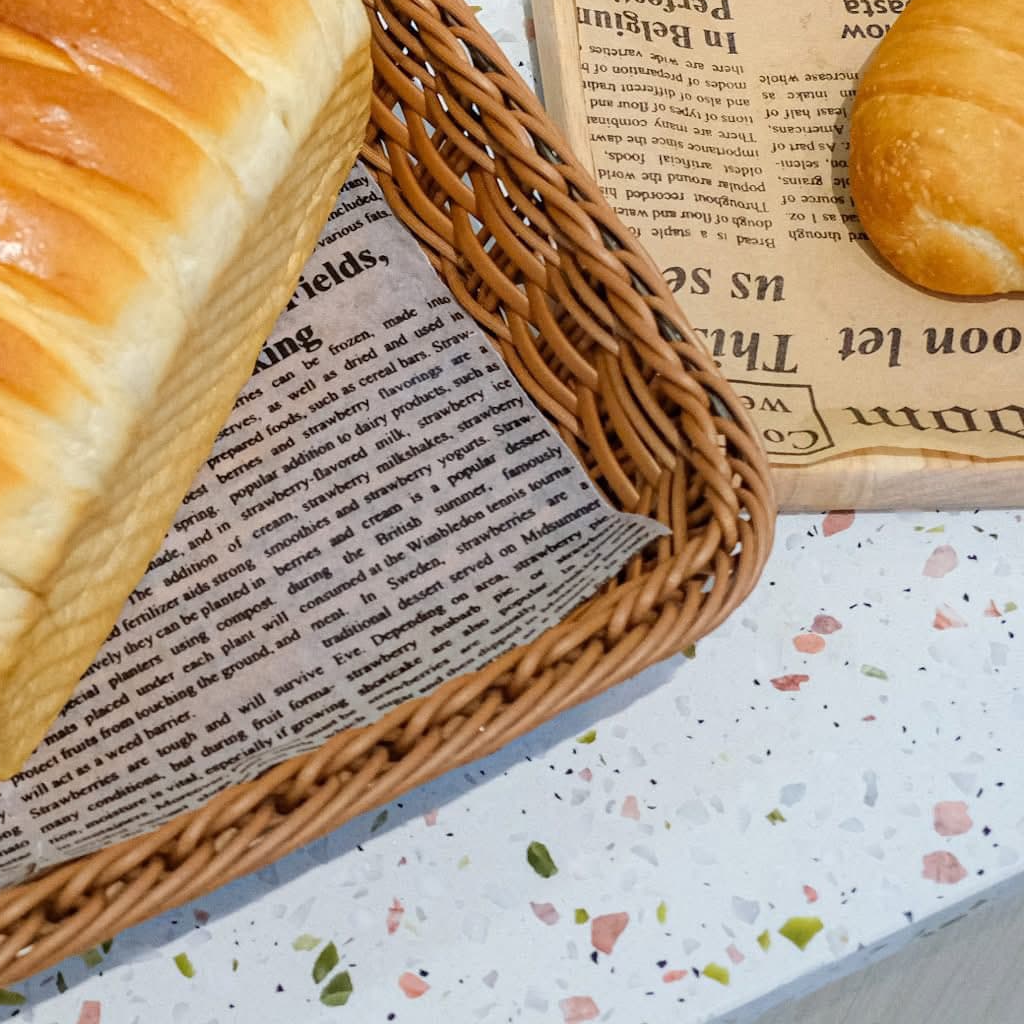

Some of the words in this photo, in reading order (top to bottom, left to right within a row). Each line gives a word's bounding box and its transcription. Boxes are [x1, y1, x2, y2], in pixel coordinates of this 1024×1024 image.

[843, 0, 911, 20] asta
[704, 29, 738, 54] In
[769, 122, 846, 139] Americans,
[659, 155, 712, 169] artificial
[598, 169, 635, 179] world
[668, 173, 712, 185] around
[626, 190, 684, 202] recorded
[718, 180, 766, 192] popular
[694, 194, 768, 212] Throughout
[652, 226, 690, 239] staple
[736, 235, 775, 248] Bread
[789, 229, 841, 242] through
[731, 272, 785, 302] us
[328, 331, 375, 355] frozen,
[383, 309, 417, 329] made
[427, 297, 451, 309] into
[838, 327, 901, 367] let
[266, 413, 307, 436] foods,
[359, 362, 397, 386] cereal
[375, 429, 410, 450] milk,
[375, 516, 422, 546] British
[435, 484, 493, 516] summer,
[502, 447, 562, 480] famously
[406, 511, 485, 552] Wimbledon
[486, 489, 527, 513] tennis
[264, 517, 330, 558] smoothies
[387, 558, 445, 590] Sweden,
[322, 606, 392, 648] traditional
[370, 605, 451, 646] Depending
